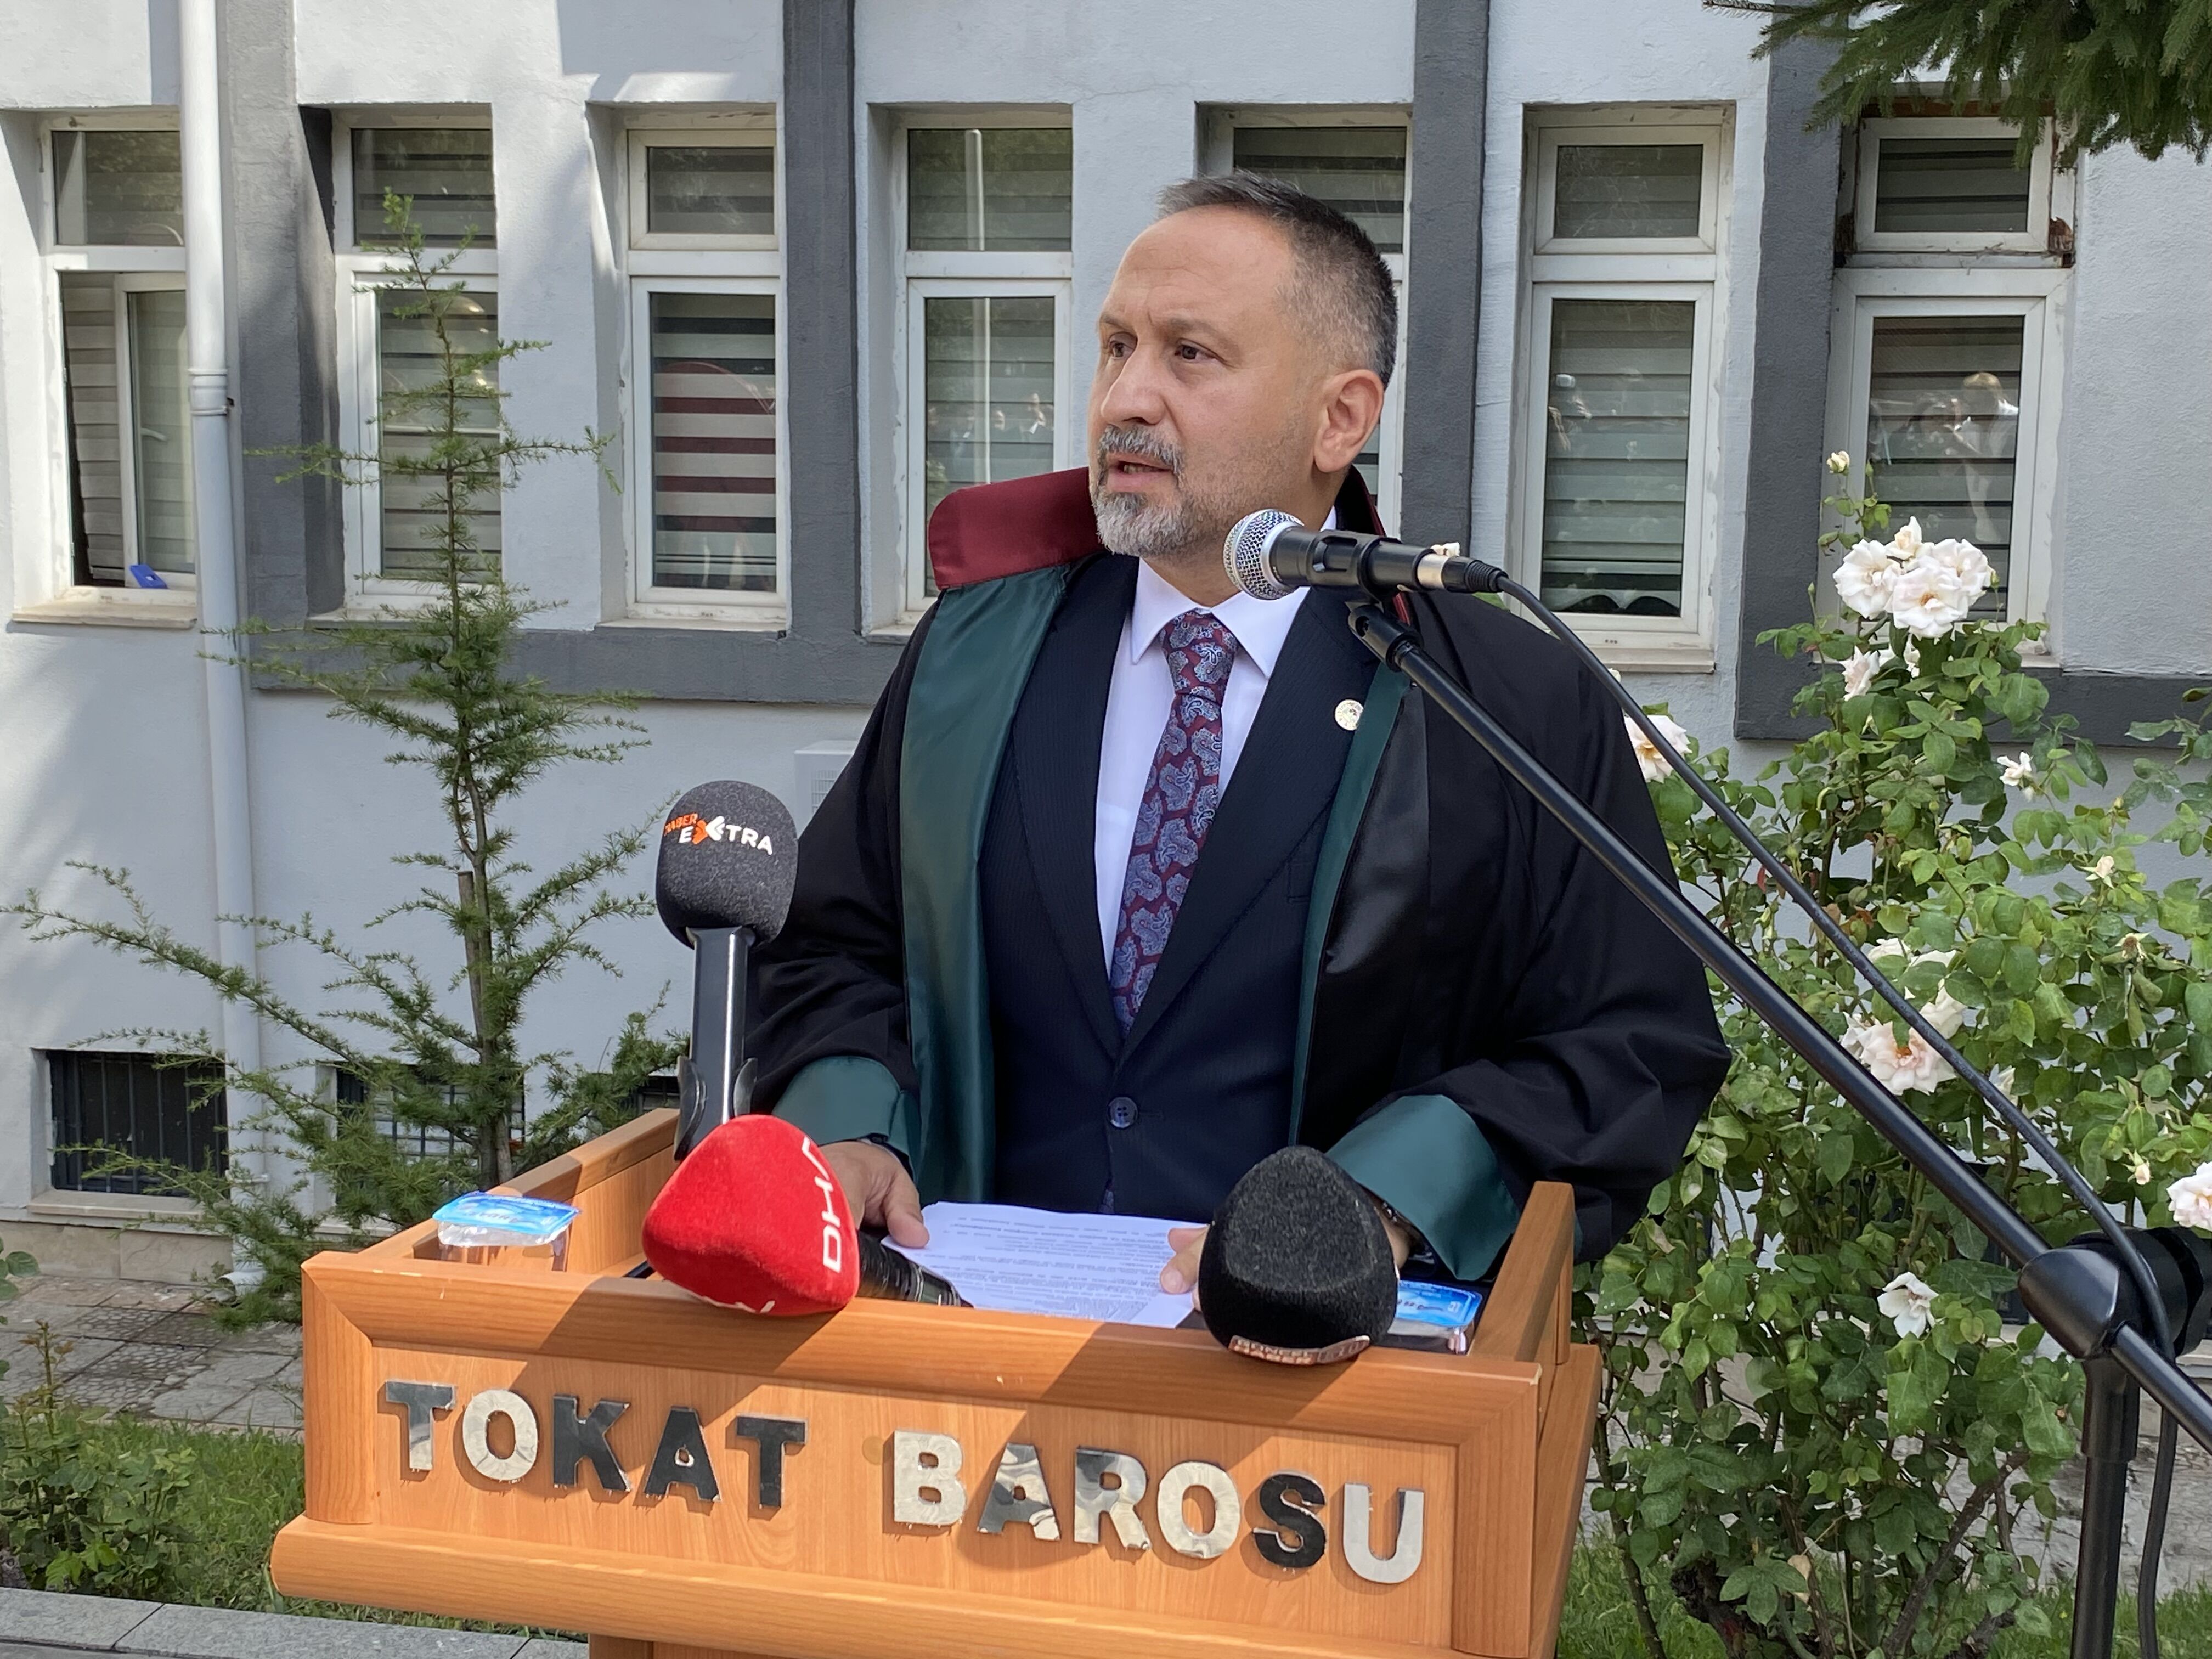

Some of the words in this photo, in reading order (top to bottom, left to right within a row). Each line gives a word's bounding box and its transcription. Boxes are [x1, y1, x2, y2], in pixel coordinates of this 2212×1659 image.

[678, 815, 772, 856] EXTRA
[385, 1379, 809, 1509] TOKAT
[893, 1429, 1425, 1585] BAROSU
